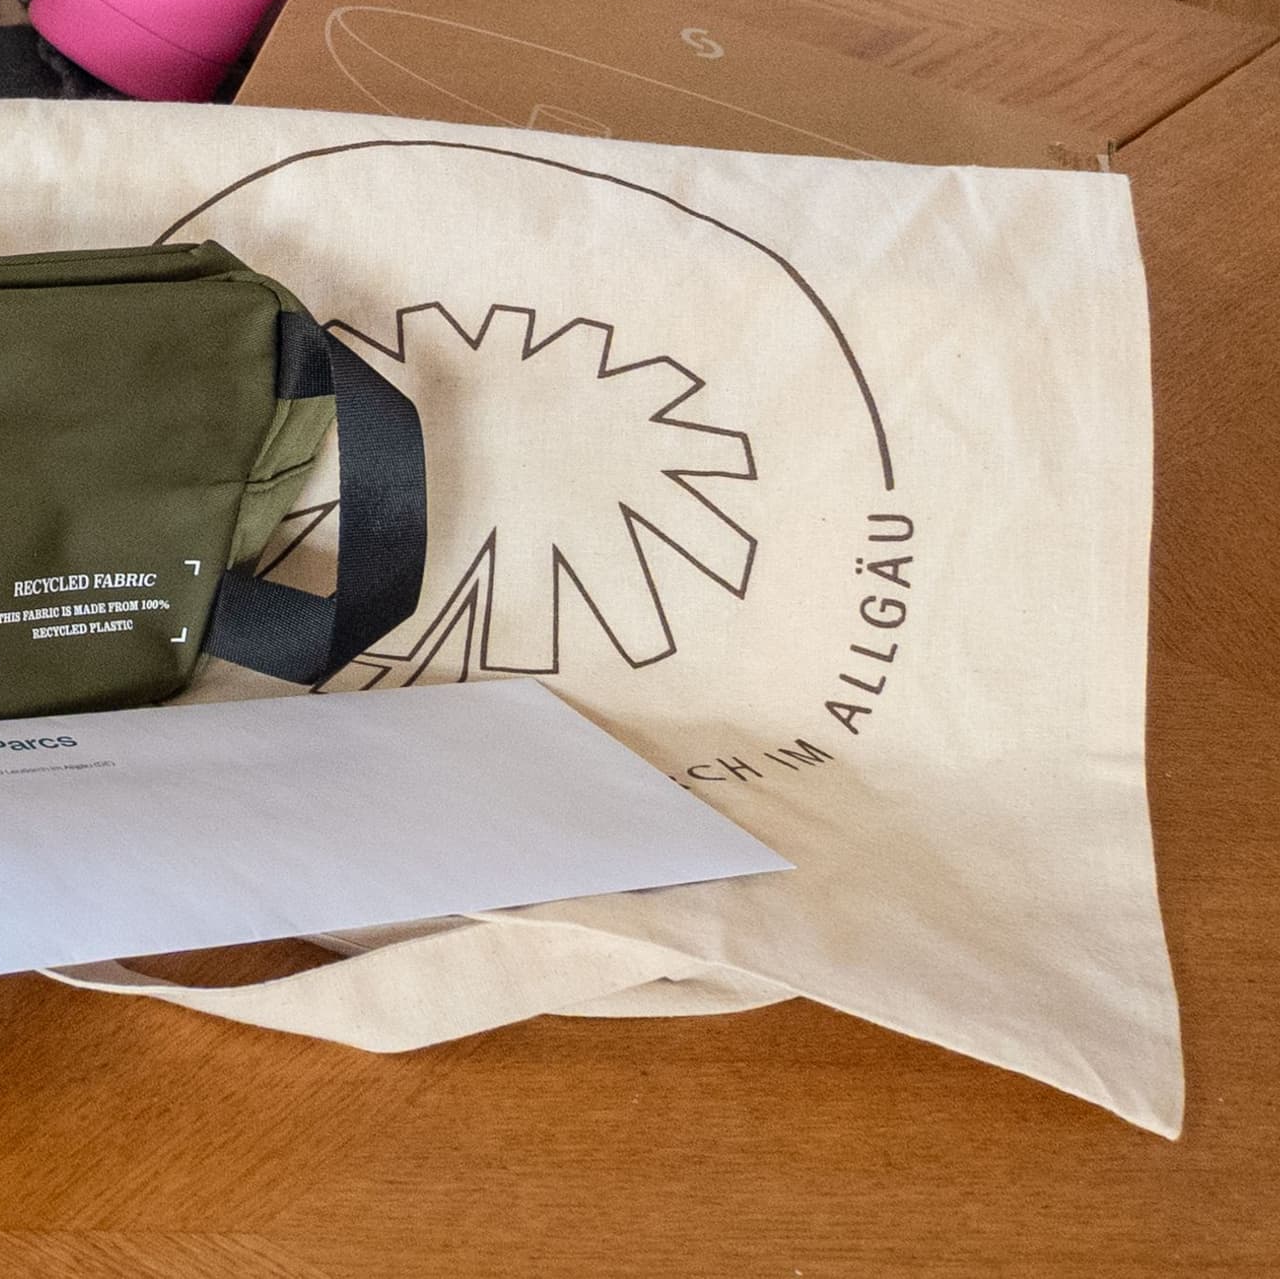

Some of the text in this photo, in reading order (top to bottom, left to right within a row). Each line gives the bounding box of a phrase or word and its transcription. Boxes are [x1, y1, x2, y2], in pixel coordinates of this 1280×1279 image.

[13, 572, 158, 598] RECYCLED FABRIC
[22, 606, 60, 622] FABRIC
[61, 605, 72, 617] IS
[73, 601, 107, 616] MADE
[107, 599, 140, 613] FROM
[140, 598, 171, 611] 100%
[31, 619, 134, 640] RECYCLED PLASTIC
[763, 738, 835, 771] IM
[824, 513, 915, 736] ALLGÄU
